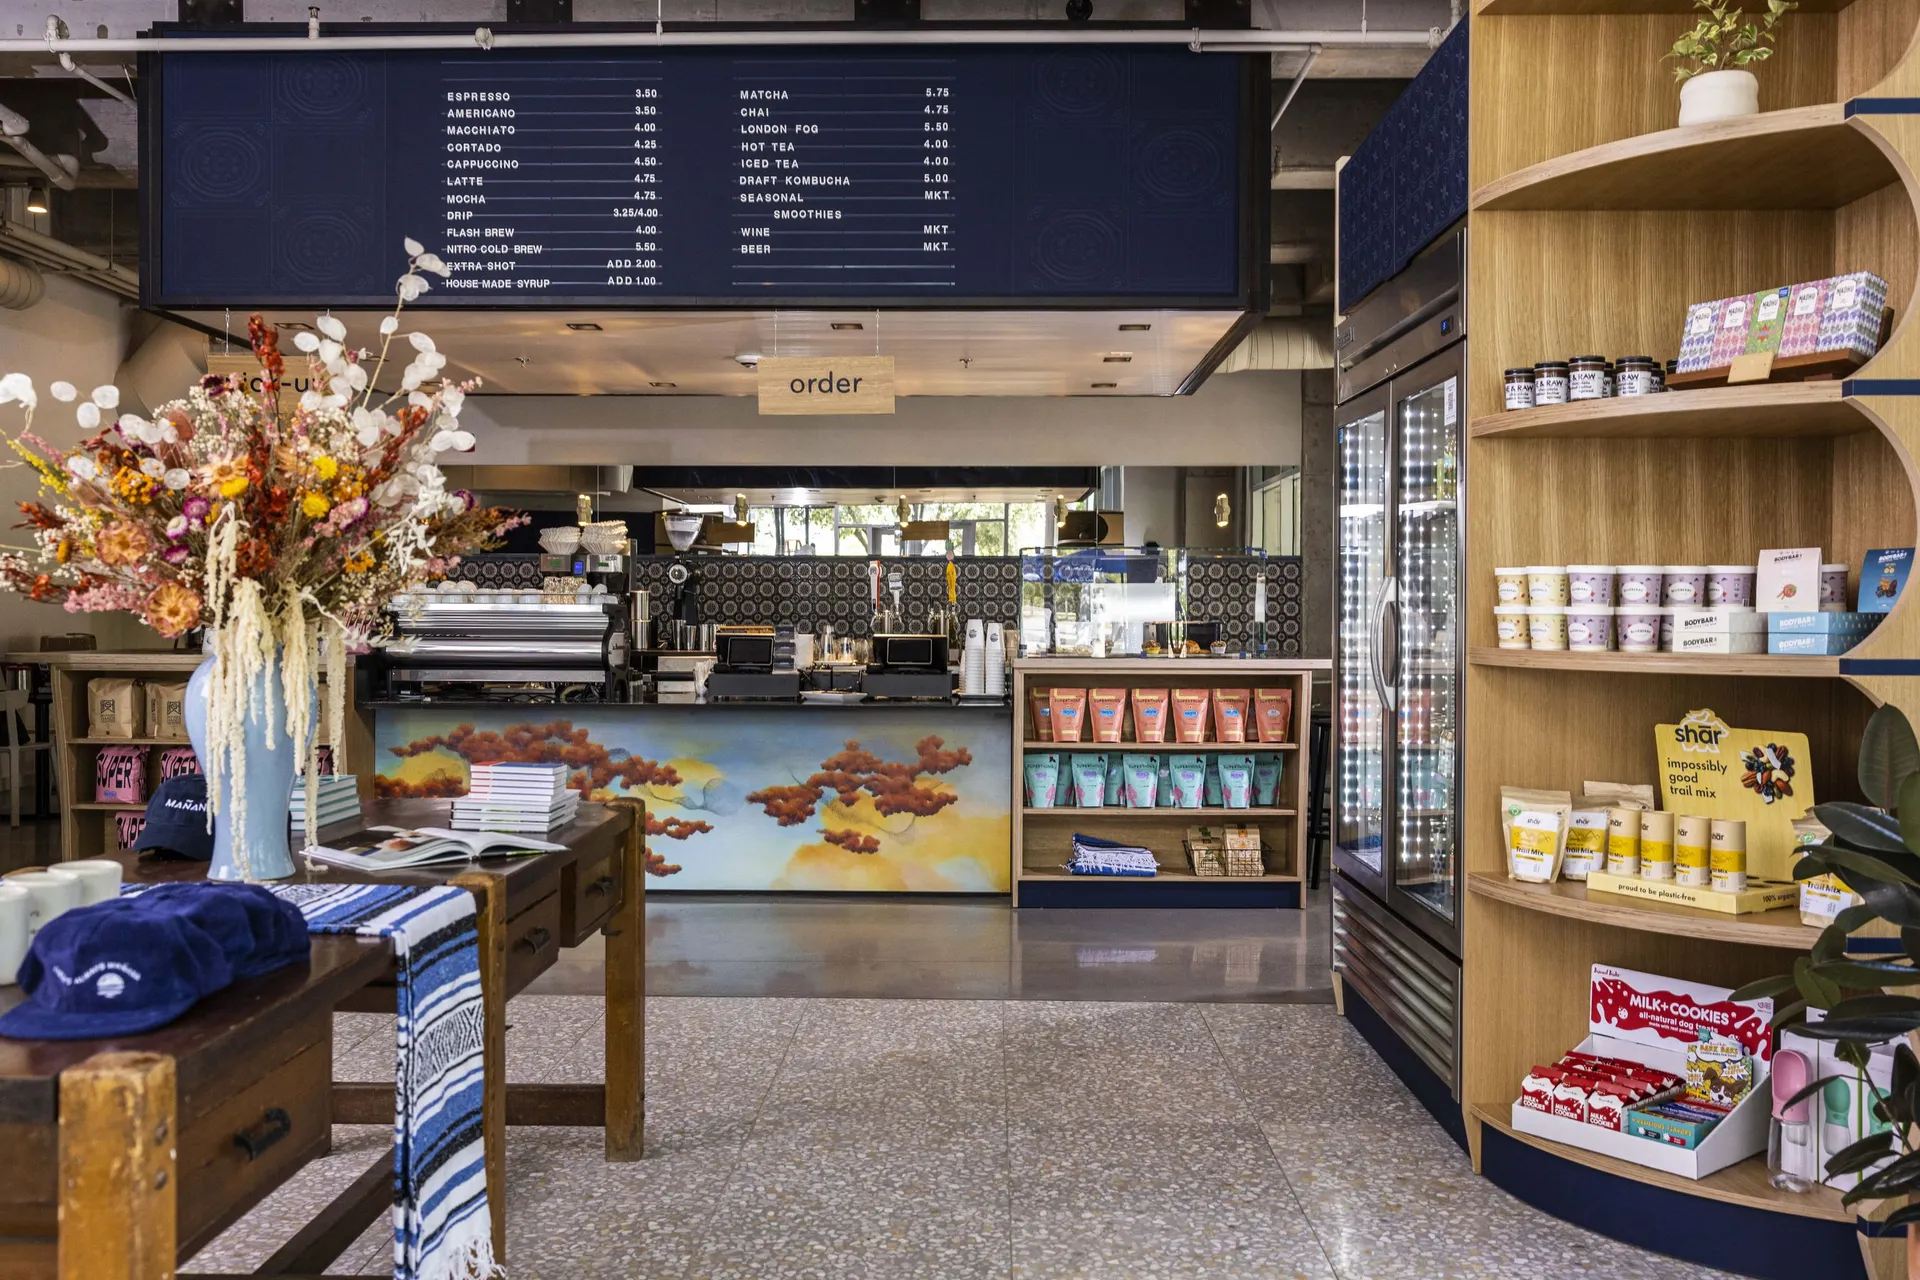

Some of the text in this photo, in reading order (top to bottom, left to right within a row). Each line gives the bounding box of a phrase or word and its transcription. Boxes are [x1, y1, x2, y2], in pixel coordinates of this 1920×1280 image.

[447, 89, 657, 102] ESPRESSO 3.50
[740, 88, 949, 100] MATCHA 5.75
[447, 106, 656, 118] AMERICANO 3.50
[740, 105, 949, 117] CHAI 4.75
[447, 123, 656, 135] MACCHIATO 4.00
[741, 122, 949, 134] LONDON FOG 5.50
[447, 140, 657, 152] CORTADO 4.25
[741, 139, 949, 152] HOT TEA 4.00
[447, 157, 657, 169] CAPPUCCINO 4.50
[741, 156, 949, 169] ICED TEA 4.00
[447, 174, 656, 186] LATTE 4.75
[739, 173, 949, 186] DRAFT KOMBUCHA 5.00
[447, 191, 656, 204] MOCHA 4.75
[740, 193, 804, 203] SEASONAL
[447, 208, 658, 220] DRIP 3.25/4.00
[773, 210, 842, 219] SMOOTHIES
[447, 226, 656, 237] FLASH BREW 4.00
[741, 227, 770, 237] WINE
[447, 242, 656, 254] NITRO COLD BREW 5.50
[741, 244, 771, 254] BEER
[446, 260, 656, 271] EXTRA SHOT ADD 2.00
[517, 279, 550, 289] SYRUP
[607, 277, 632, 285] ADD
[635, 277, 656, 285] 1.00
[790, 371, 862, 393] order
[1518, 384, 1534, 392] RAW
[1684, 616, 1714, 626] BODYBAR
[1683, 638, 1713, 646] BODYBAR
[96, 753, 133, 788] SUPER
[1668, 758, 1727, 775] impossibly
[1669, 772, 1698, 784] good
[1670, 785, 1716, 798] trail mix
[165, 799, 207, 812] MAÑAN
[116, 817, 147, 851] SUPE
[1531, 848, 1544, 856] Mix
[1618, 884, 1638, 892] proud
[1659, 890, 1696, 902] plastic-free
[1807, 881, 1842, 894] Trail Mix
[1778, 892, 1796, 902] organic
[1639, 1012, 1677, 1025] all-natural
[1679, 1020, 1693, 1030] dog
[1523, 1100, 1545, 1110] COOKIES
[1555, 1109, 1577, 1119] COOKIES
[1590, 1118, 1613, 1128] COOKIES
